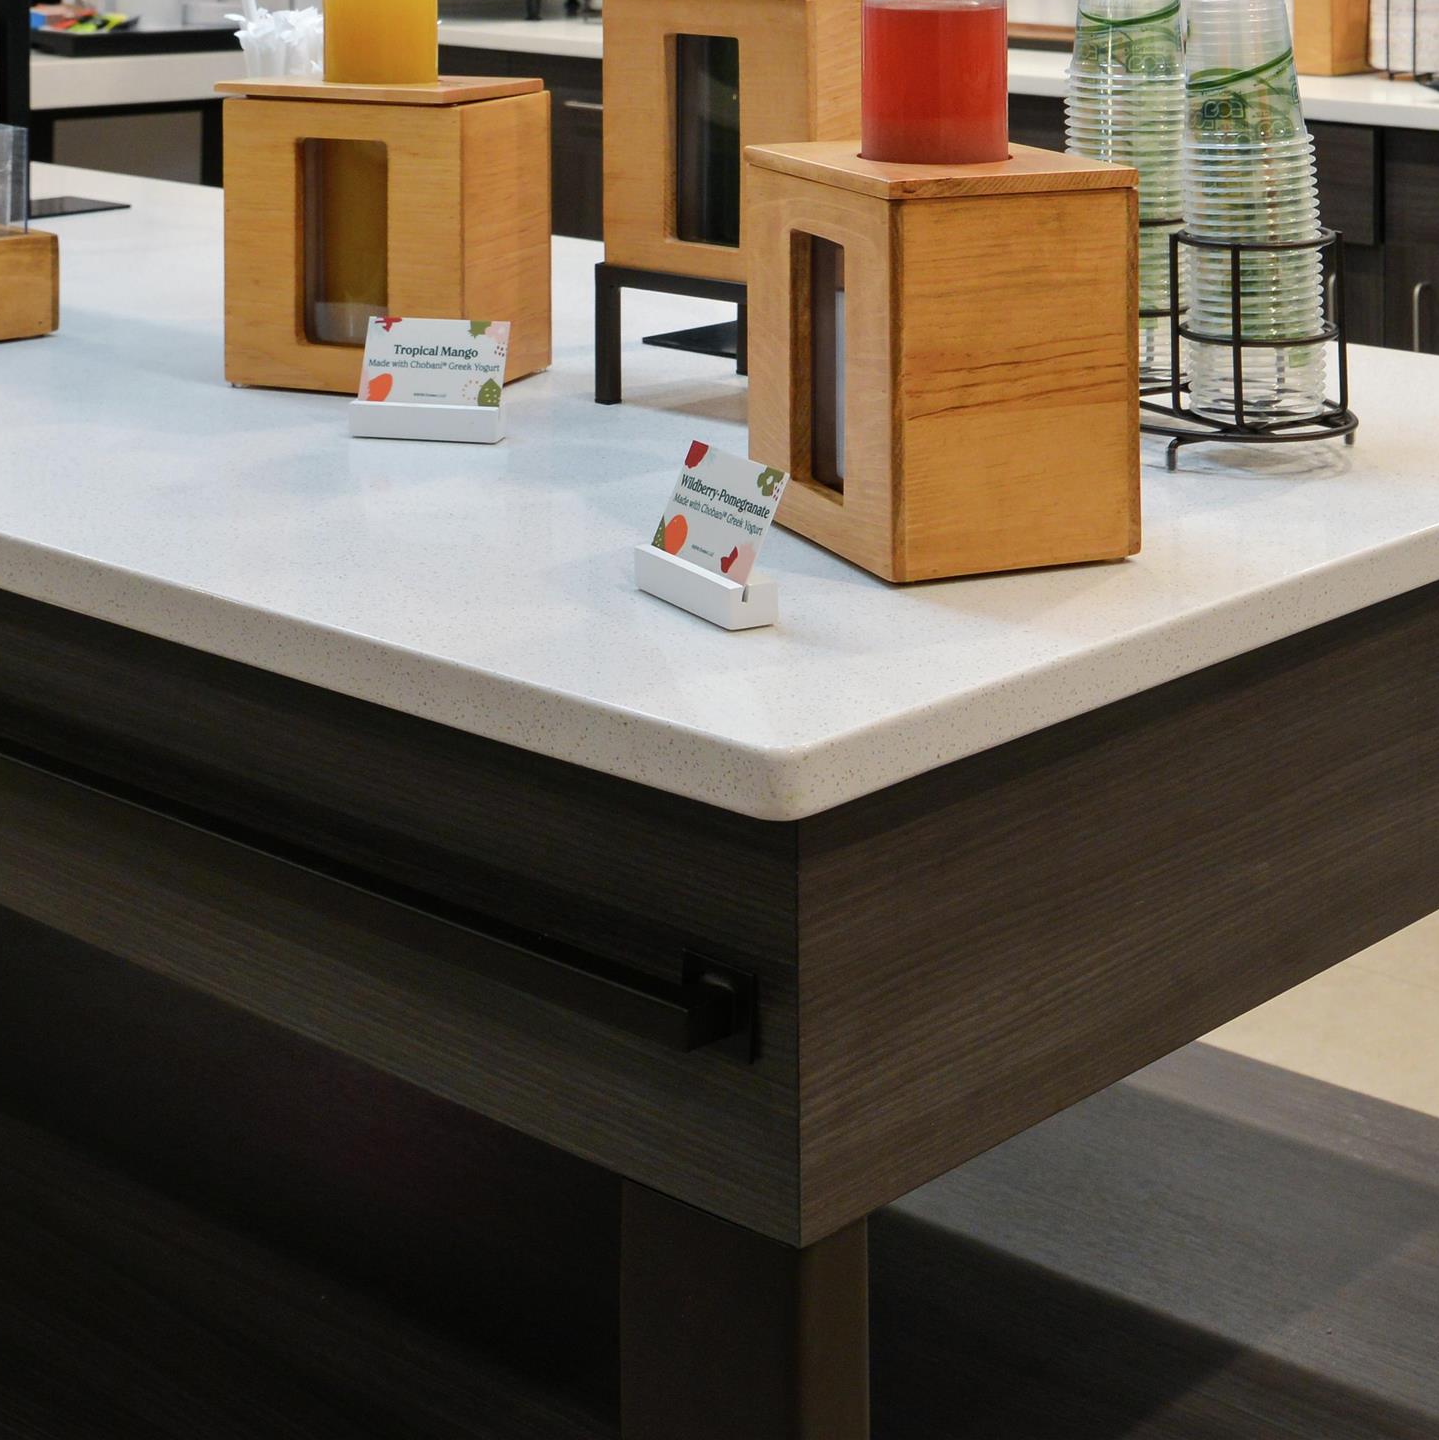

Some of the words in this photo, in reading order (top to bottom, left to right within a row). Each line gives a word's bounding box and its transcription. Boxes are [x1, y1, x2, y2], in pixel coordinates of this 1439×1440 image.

[394, 344, 439, 357] Tropical
[442, 346, 479, 360] Mango
[369, 359, 390, 368] Made
[392, 360, 409, 368] with
[448, 362, 472, 371] Greek
[474, 364, 500, 373] Yogurt
